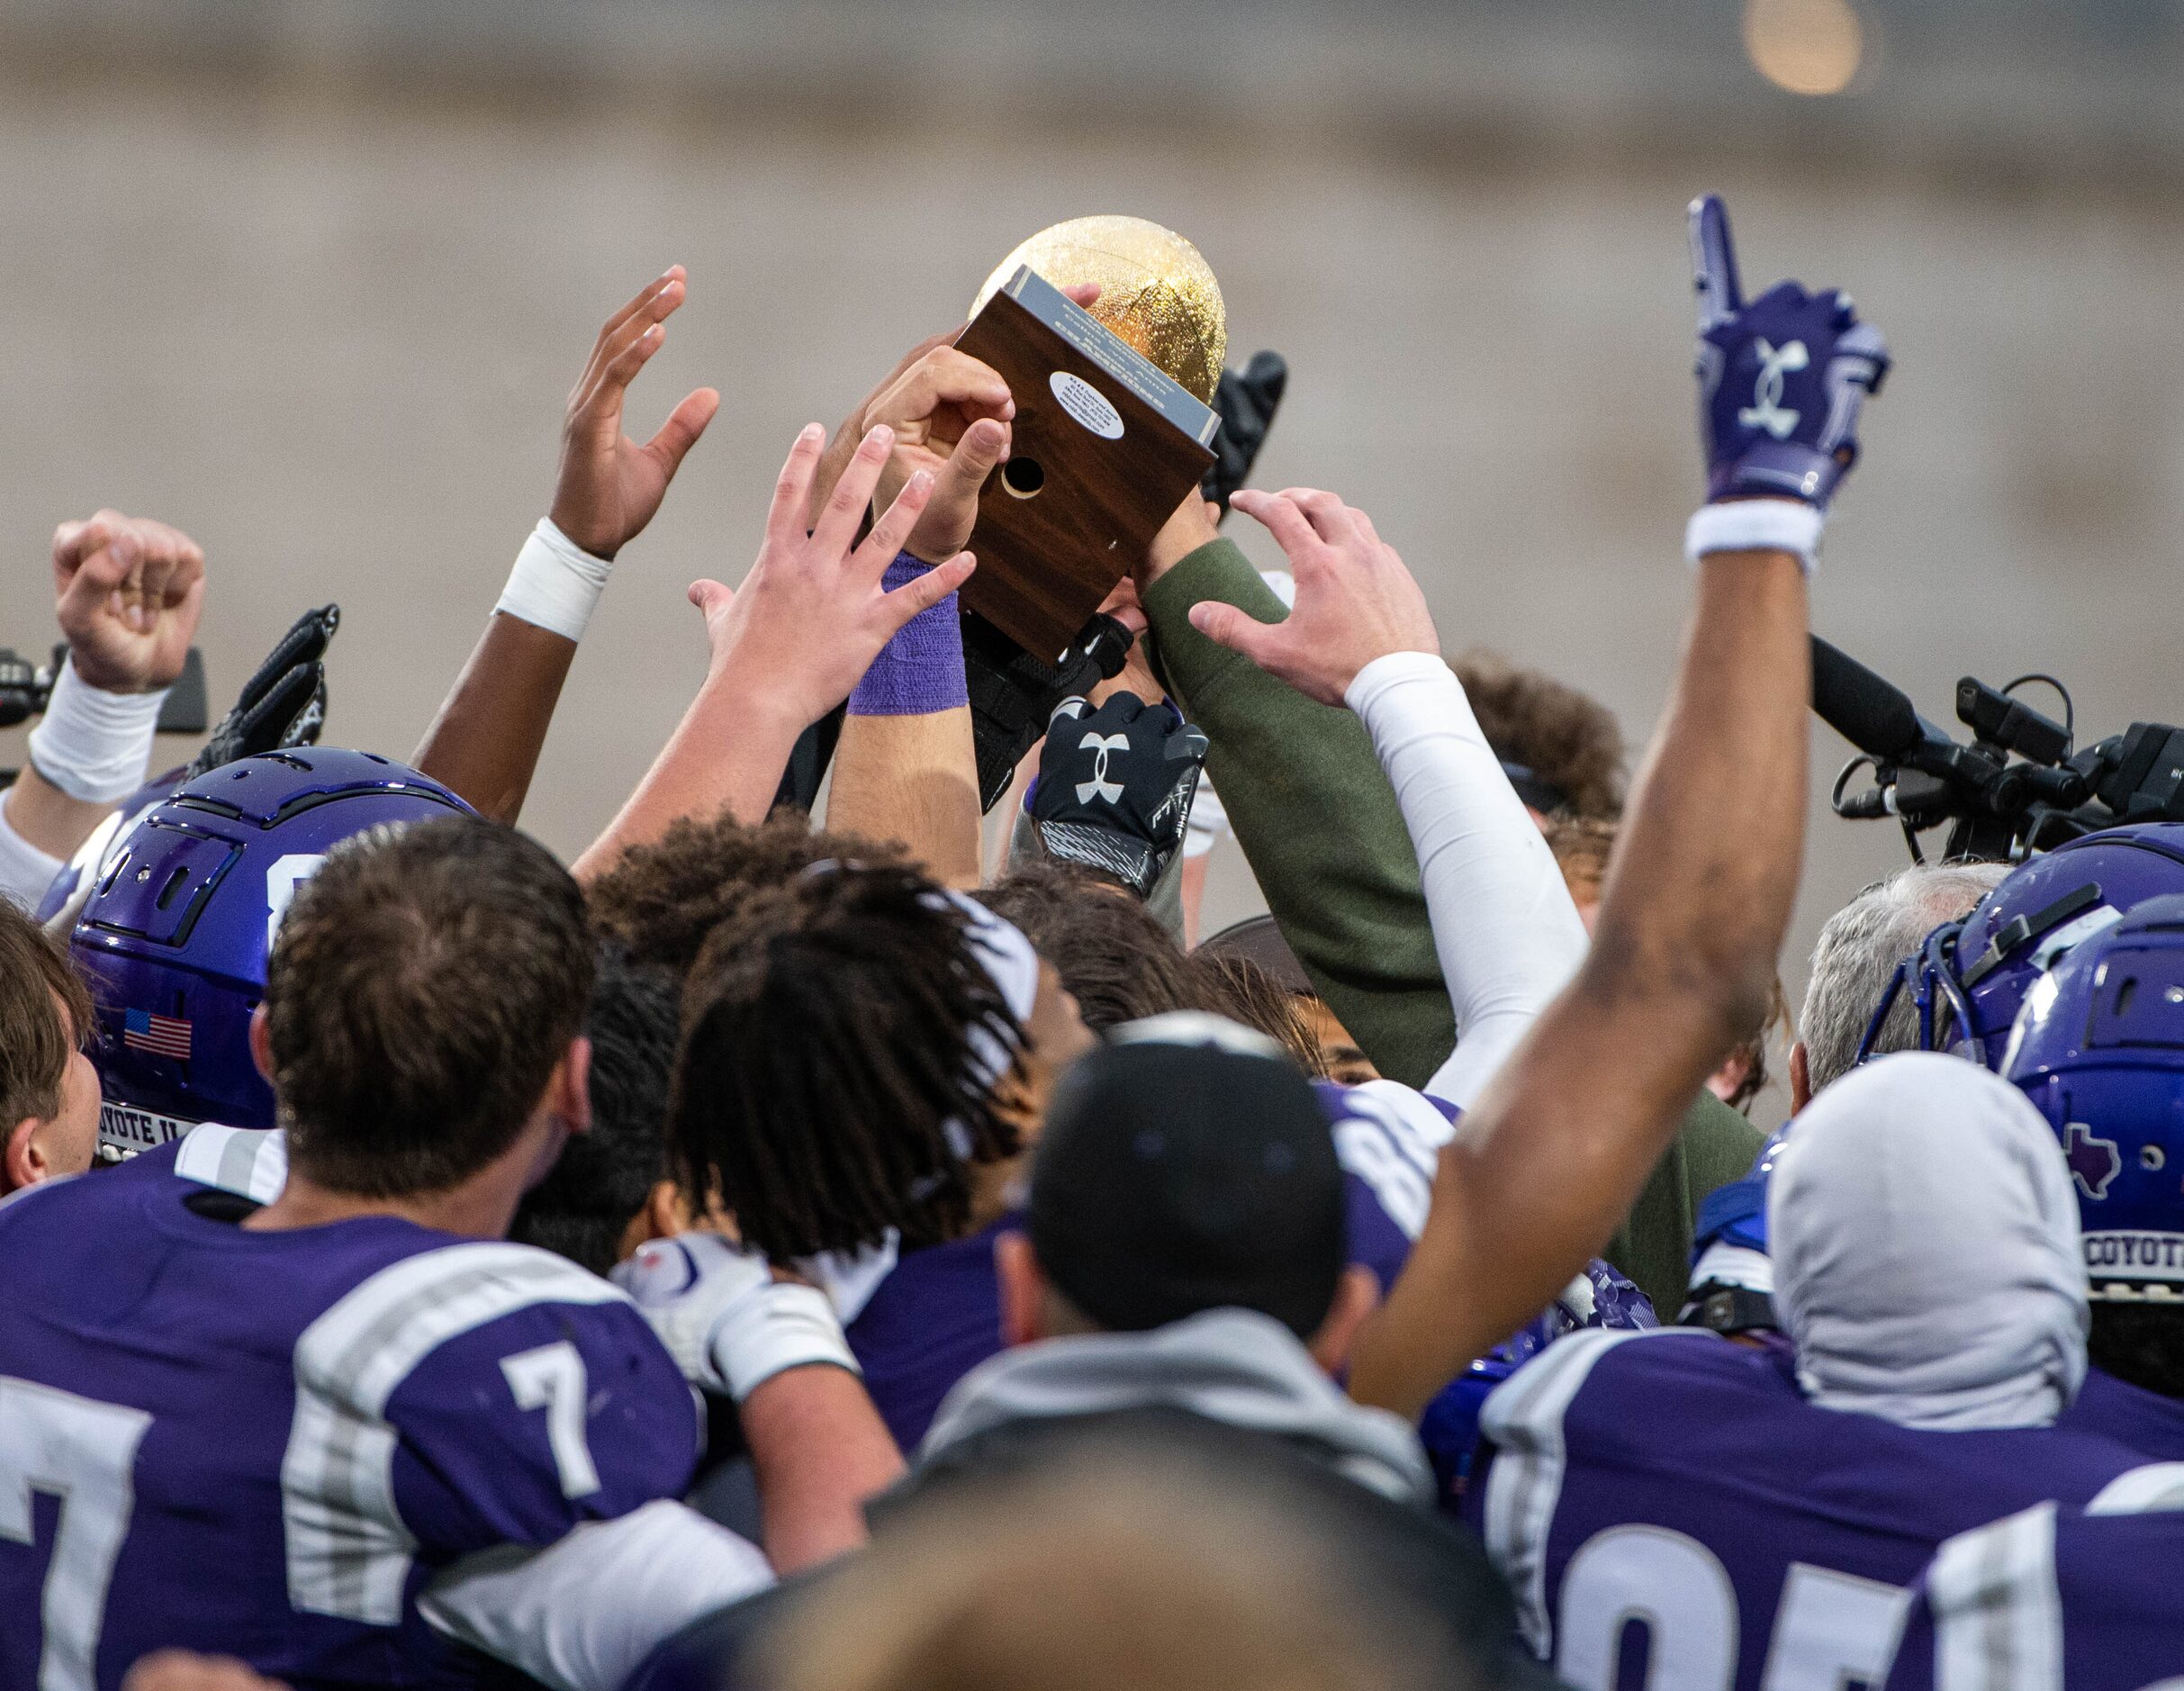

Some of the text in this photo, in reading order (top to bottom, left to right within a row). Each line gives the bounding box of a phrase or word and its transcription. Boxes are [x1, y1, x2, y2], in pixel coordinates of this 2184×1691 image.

[1053, 320, 1166, 410] CHAMPIONS
[100, 1106, 156, 1144] OYOTE
[2084, 1236, 2184, 1266] COYOT
[499, 1340, 601, 1498] 7
[0, 1375, 156, 1691] 7
